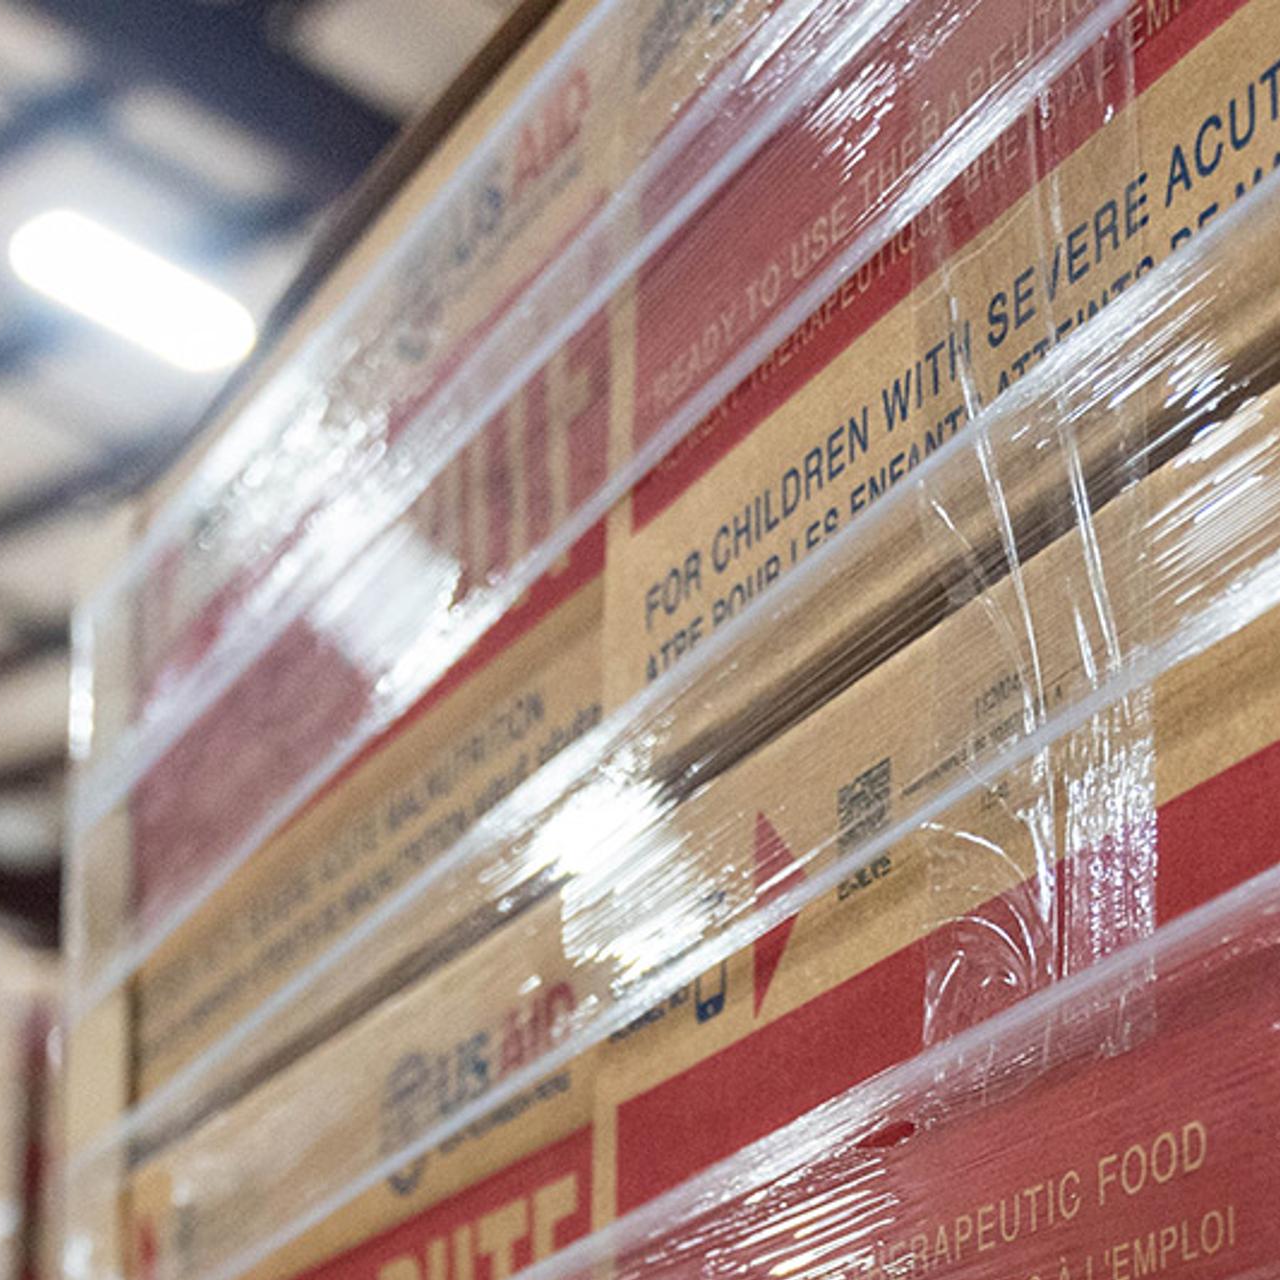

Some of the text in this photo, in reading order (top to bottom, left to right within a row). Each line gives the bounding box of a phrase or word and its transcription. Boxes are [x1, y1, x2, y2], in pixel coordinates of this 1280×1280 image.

[746, 264, 780, 330] TO
[790, 198, 851, 279] USE
[645, 551, 701, 630] FOR
[712, 406, 868, 574] CHILDREN
[882, 320, 970, 432] WITH
[987, 173, 1149, 348] SEVERE
[1098, 1121, 1208, 1204] FOOD
